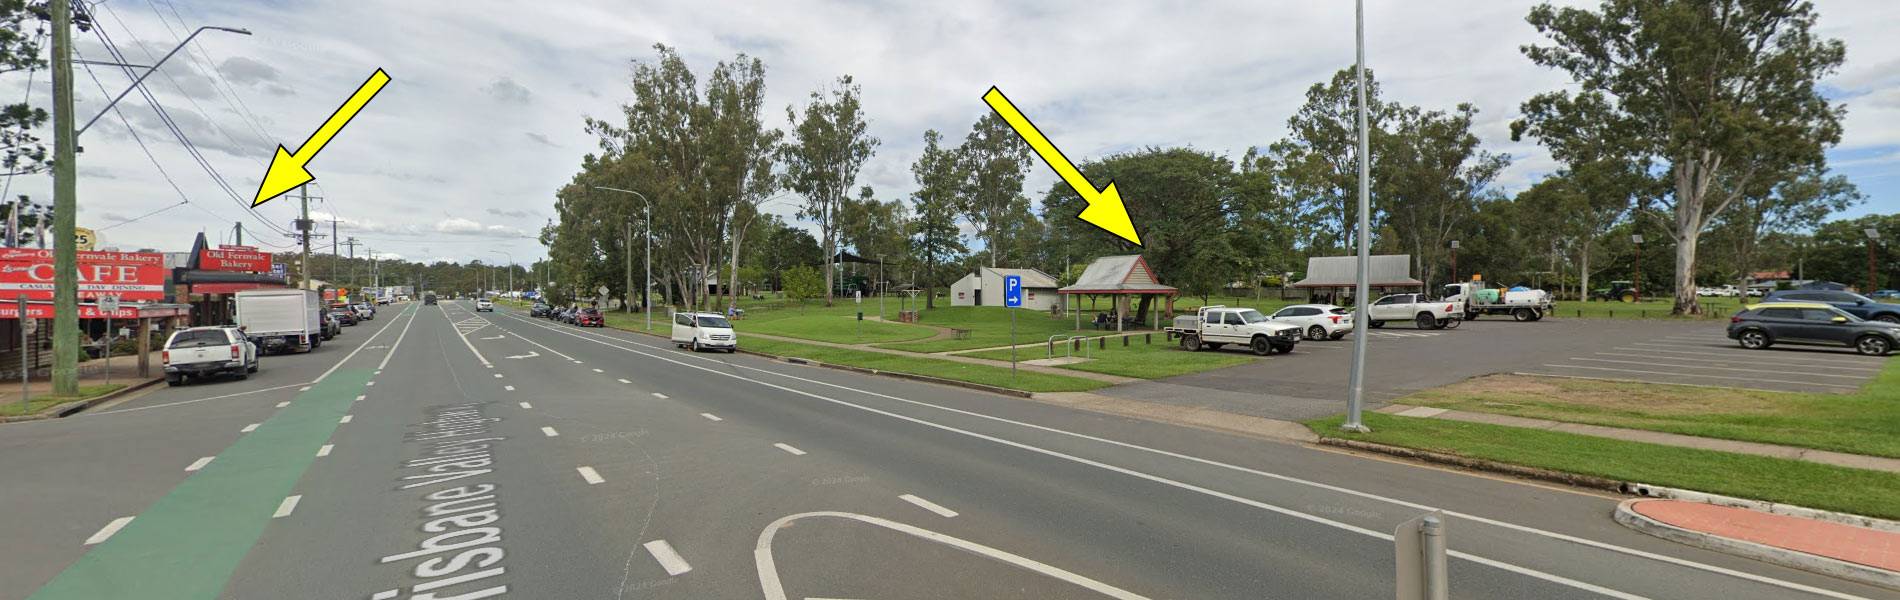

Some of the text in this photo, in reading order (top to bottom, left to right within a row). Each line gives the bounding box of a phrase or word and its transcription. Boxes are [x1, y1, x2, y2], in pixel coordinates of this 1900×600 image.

[76, 253, 116, 261] ernvale
[120, 253, 161, 265] Bakery
[207, 251, 266, 261] Old Fernvale
[221, 260, 254, 270] Bakery
[1009, 278, 1018, 292] P
[402, 437, 505, 489] Valley
[372, 484, 507, 600] risbane
